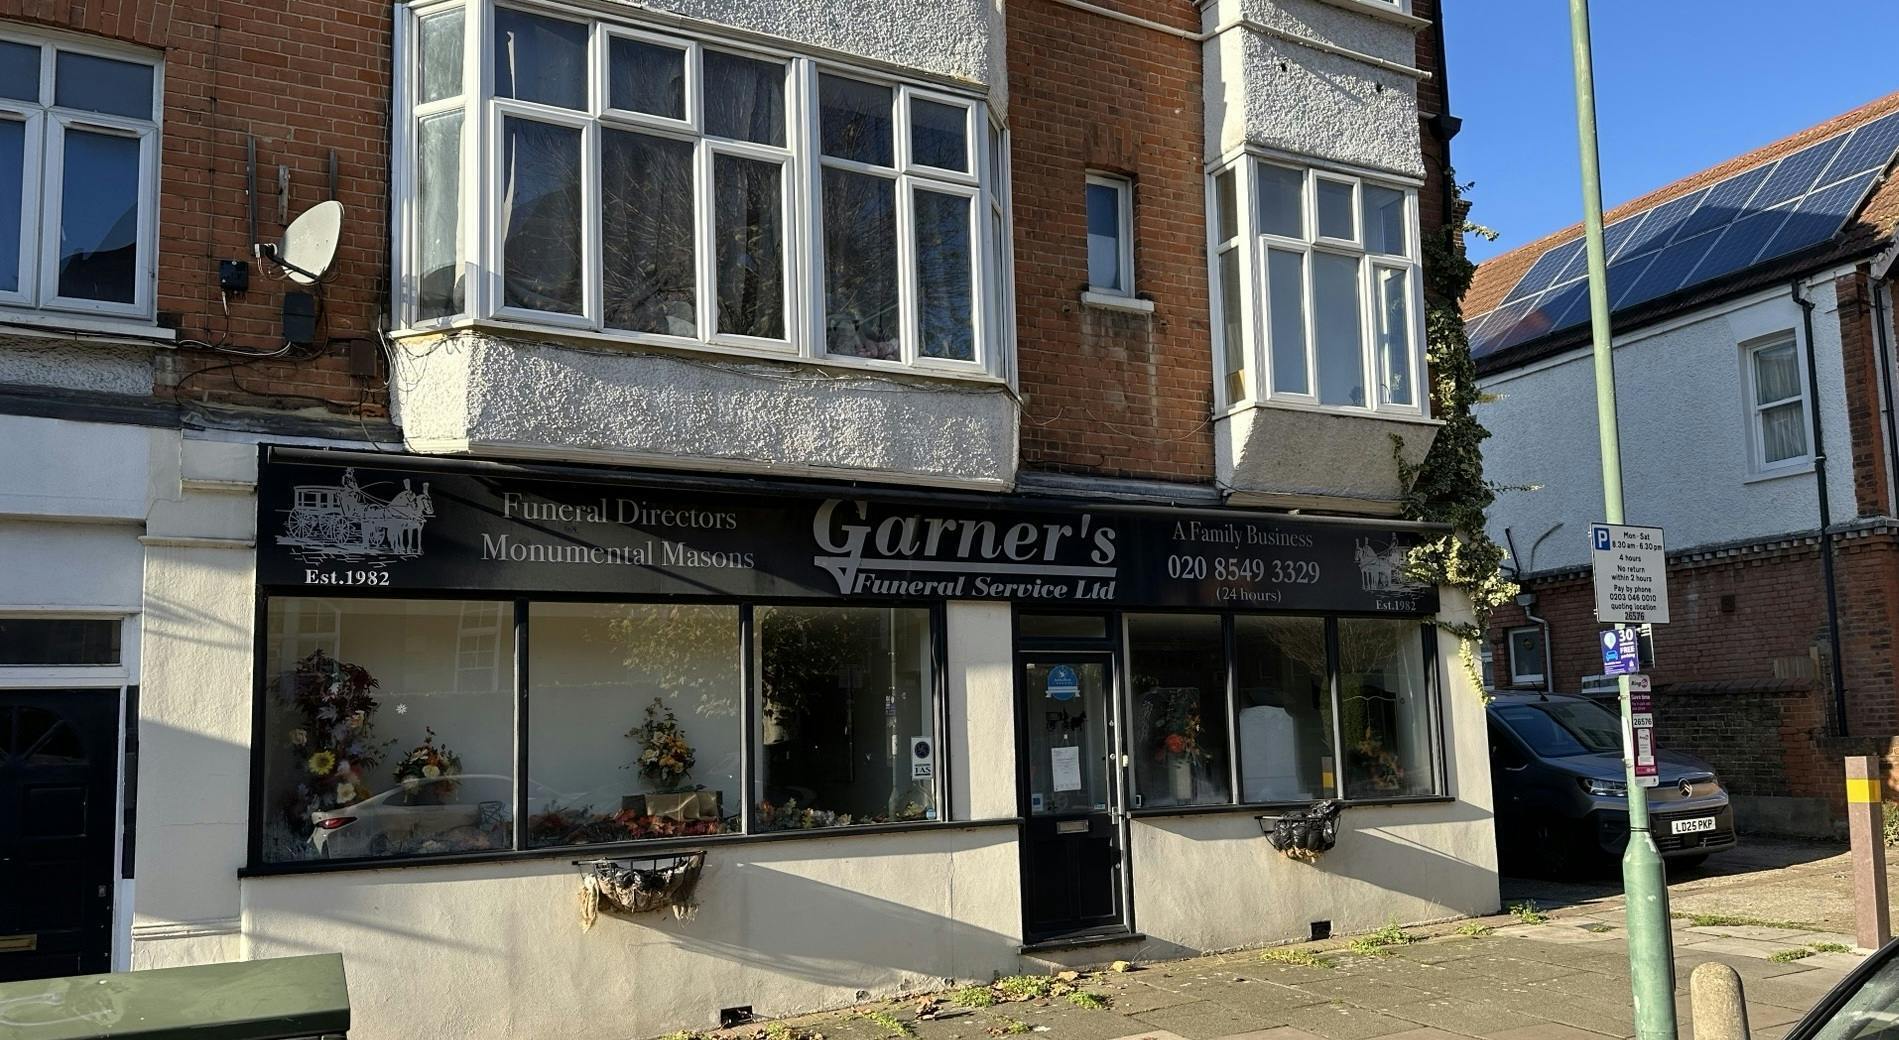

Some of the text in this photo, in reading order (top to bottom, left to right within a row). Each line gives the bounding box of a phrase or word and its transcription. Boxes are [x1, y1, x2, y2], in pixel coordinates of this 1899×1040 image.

[503, 491, 737, 530] Funeral Directors
[813, 498, 1117, 565] Garner's
[1172, 520, 1313, 549] A Family Business
[1597, 530, 1608, 548] P
[1623, 531, 1636, 539] Mon
[1640, 532, 1650, 540] Sat
[481, 533, 755, 569] Monumental Masons
[1625, 554, 1641, 562] hours
[305, 569, 390, 587] Est.1982
[1168, 555, 1321, 584] 020 8549 3329
[853, 573, 1116, 600] Funeral Service Ltd
[1216, 586, 1282, 603] (24 hours)
[1626, 585, 1633, 593] by
[1634, 586, 1651, 594] phone
[1376, 600, 1416, 611] Est.1982
[1609, 593, 1626, 601] 0203
[1619, 629, 1633, 641] 30
[1676, 819, 1712, 832] LD25 PKP
